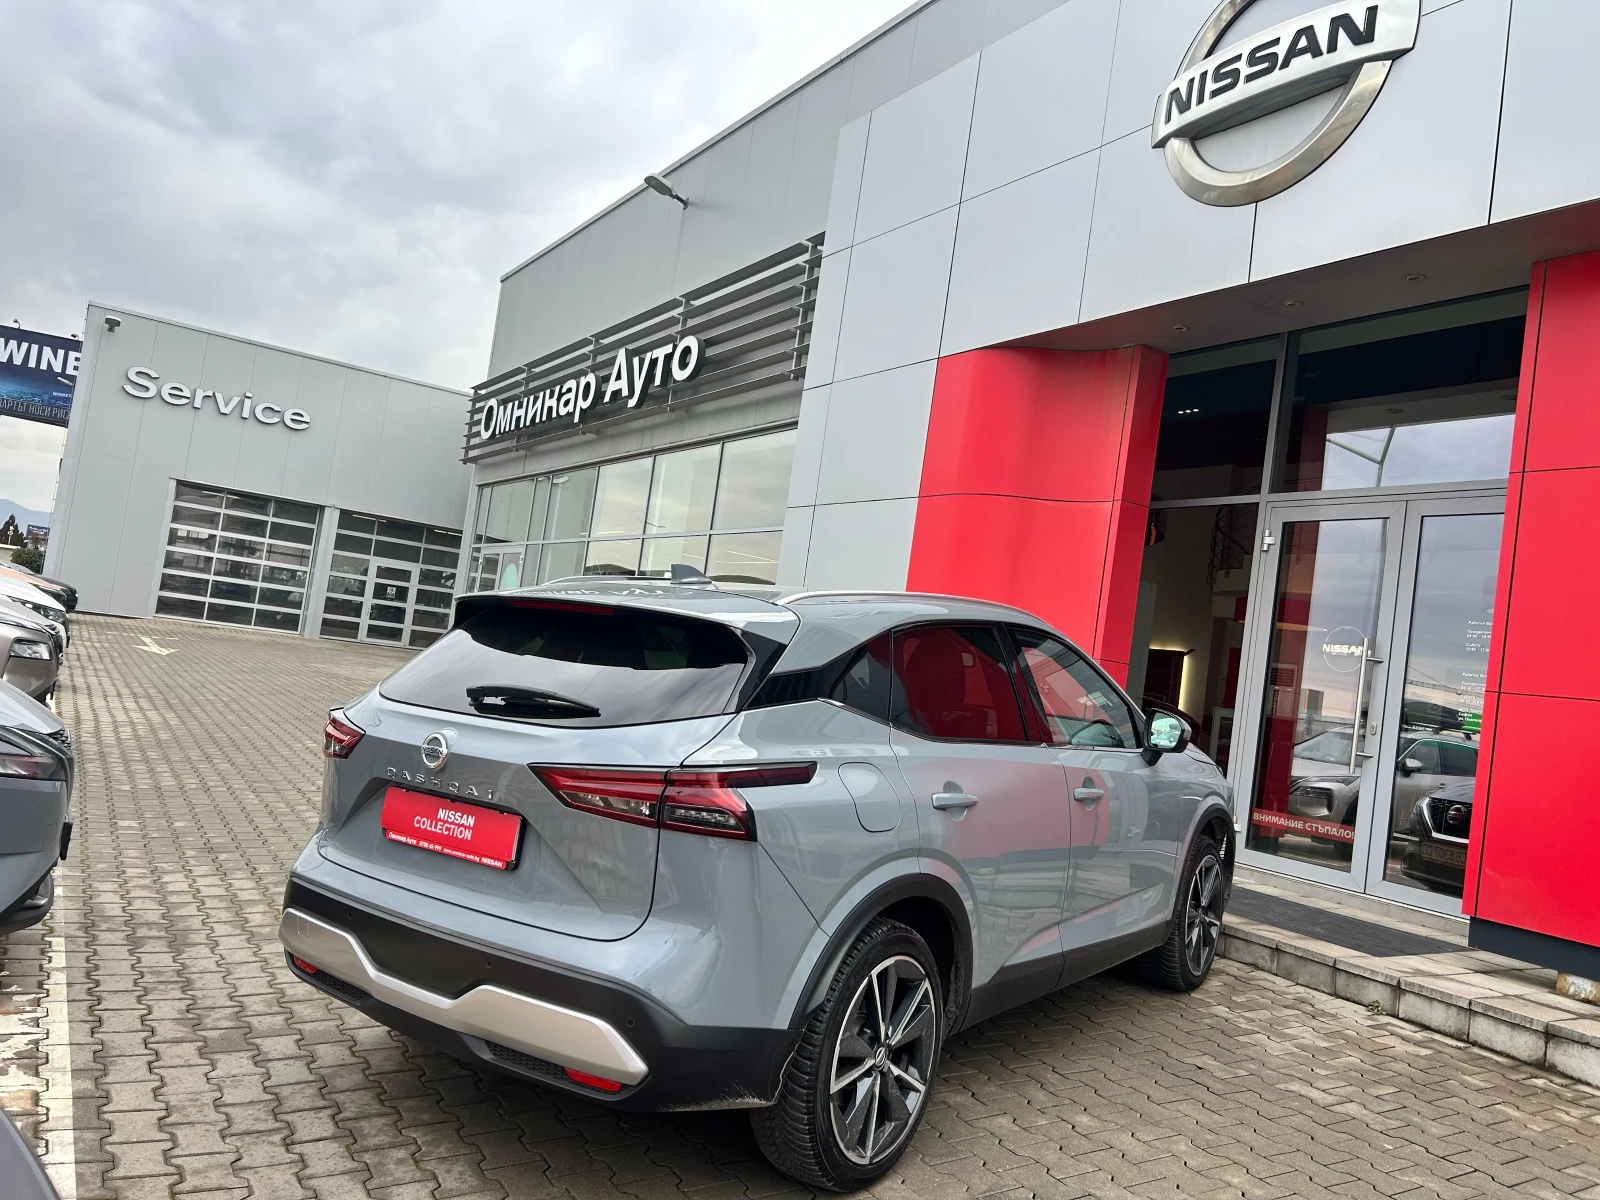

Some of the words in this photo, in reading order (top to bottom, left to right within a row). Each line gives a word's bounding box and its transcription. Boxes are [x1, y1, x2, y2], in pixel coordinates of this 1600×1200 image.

[1164, 4, 1378, 125] NISSAN
[122, 365, 311, 431] Service
[480, 372, 597, 440] Омникар
[603, 335, 700, 408] Ауто
[28, 403, 51, 416] НОСИ
[422, 746, 444, 755] NISSAN
[386, 767, 494, 800] QASHQAI
[413, 815, 473, 841] COLLECTION
[437, 808, 476, 828] NISSAN
[1253, 812, 1304, 830] ВНИМАНИЕ
[1305, 822, 1354, 840] СТЪПАЛО!
[481, 857, 503, 868] NISSAN
